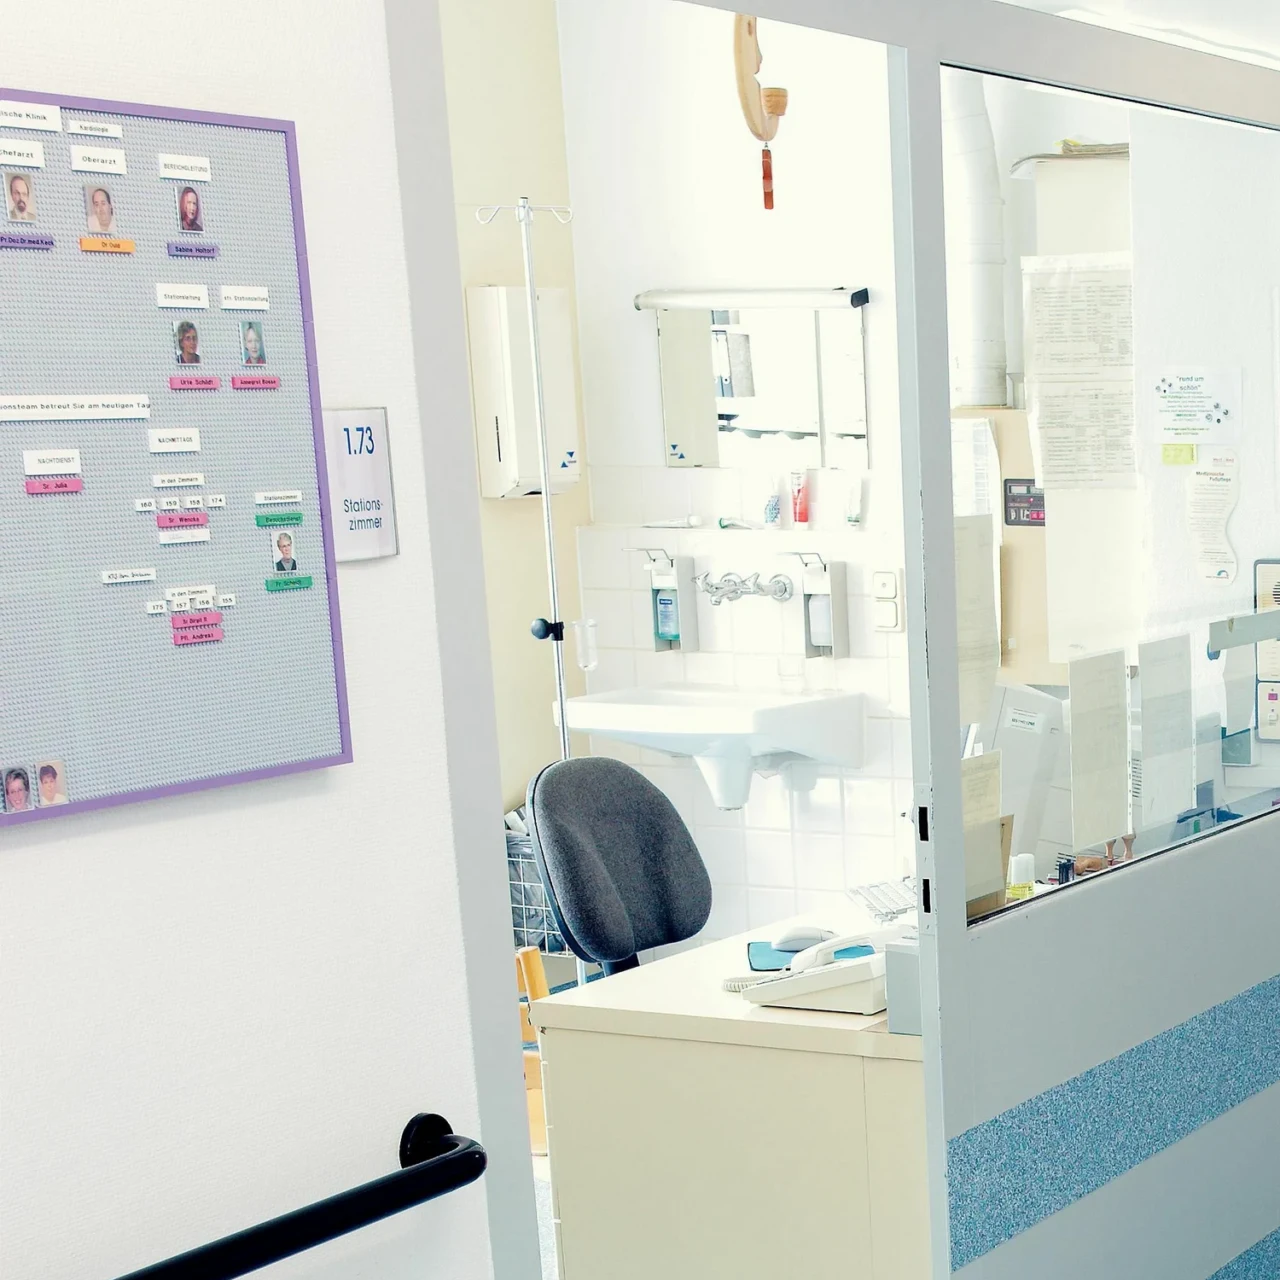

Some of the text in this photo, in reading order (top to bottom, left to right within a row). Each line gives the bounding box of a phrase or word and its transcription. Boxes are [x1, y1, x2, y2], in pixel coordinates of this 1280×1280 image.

[0, 110, 48, 121] ische Klinik
[82, 156, 117, 165] Oberarzt
[343, 426, 375, 455] 1.73
[343, 498, 383, 513] Stations-
[349, 516, 382, 531] zimmer
